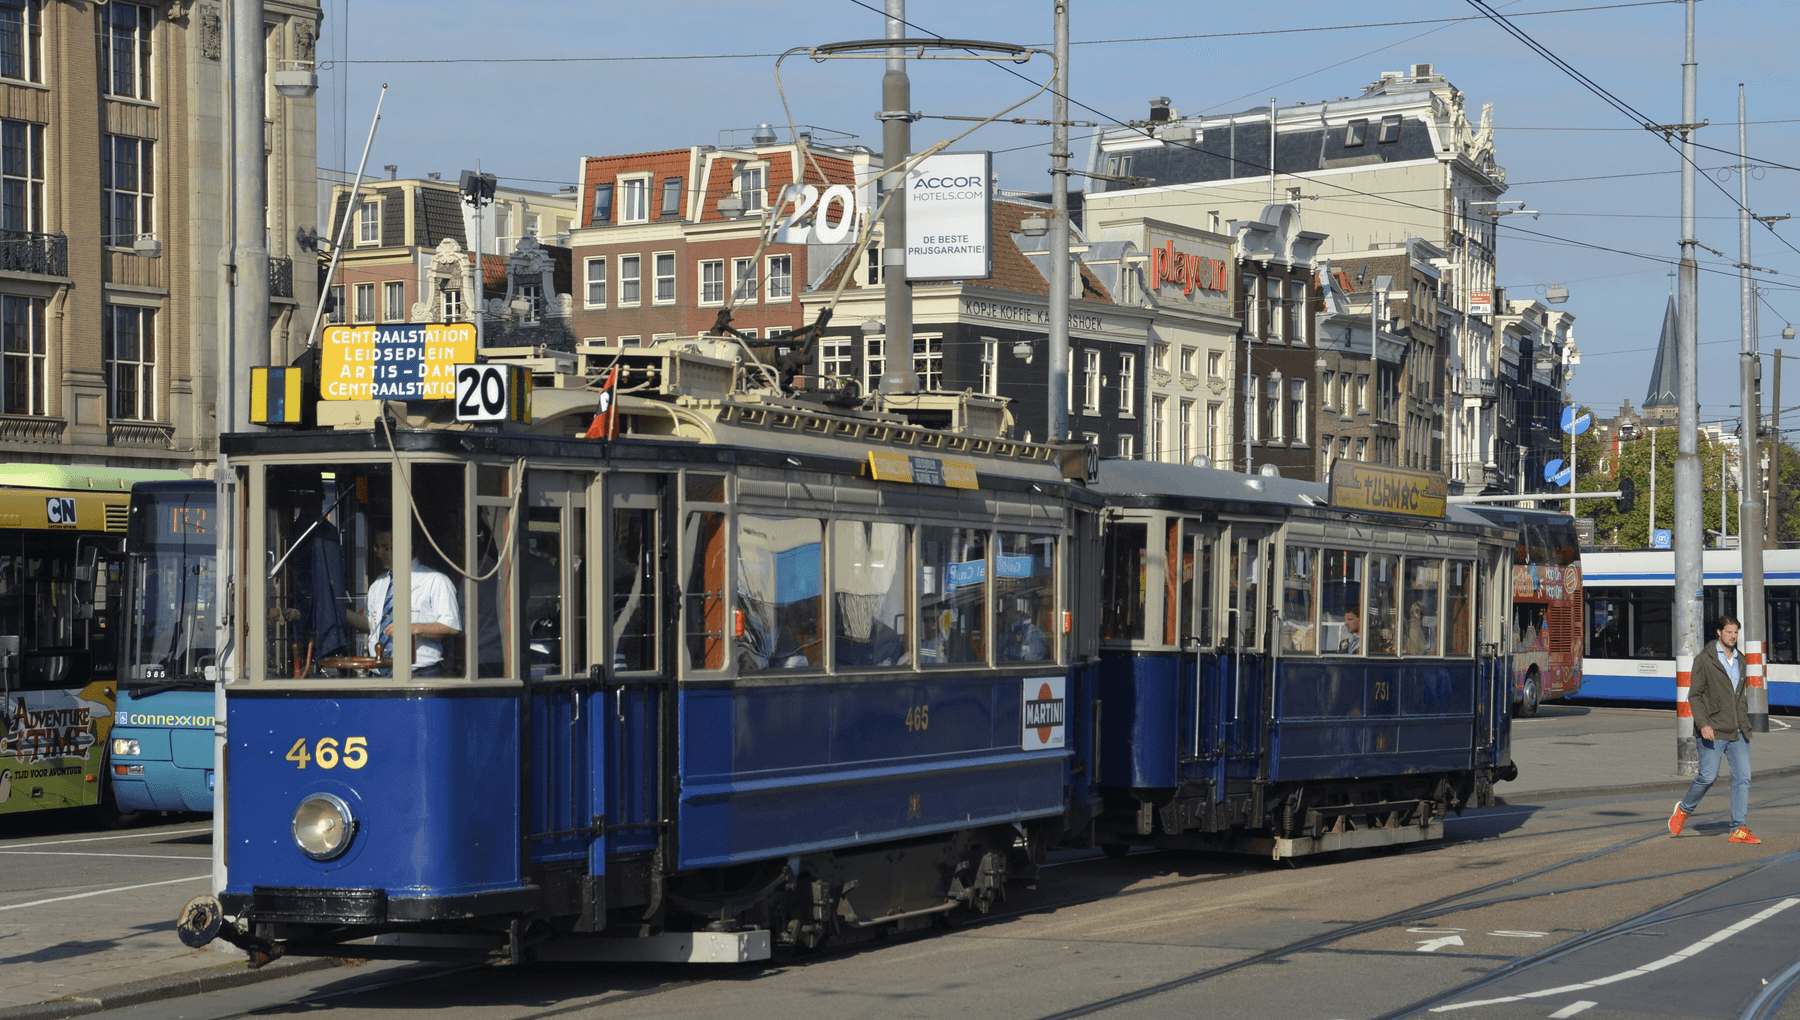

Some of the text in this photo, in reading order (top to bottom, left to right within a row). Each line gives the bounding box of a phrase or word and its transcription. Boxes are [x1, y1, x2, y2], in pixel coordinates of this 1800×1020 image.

[914, 176, 983, 189] ACCOR
[914, 191, 983, 201] HOTELS.COM
[776, 184, 854, 244] 20
[923, 235, 969, 244] DE BESTE
[908, 245, 985, 255] PRIJSGARANTIE!
[966, 300, 997, 318] KOPJE
[1000, 305, 1031, 322] KOFFIE
[331, 328, 469, 345] CENTRAALSTATION
[344, 347, 455, 361] LEIDSEPLEIN
[340, 364, 398, 379] ARTIS
[418, 363, 456, 378] DAM
[329, 381, 456, 396] CENTRAALSTATIO
[458, 367, 505, 416] 20
[47, 498, 77, 524] CN
[1375, 682, 1390, 700] 731
[10, 696, 91, 731] ADVENTURE
[905, 704, 929, 732] 465
[1026, 701, 1063, 725] MARTINI
[26, 726, 88, 761] TIME
[285, 736, 369, 770] 465
[15, 766, 82, 779] TIJD VOOR AVONTUUR
